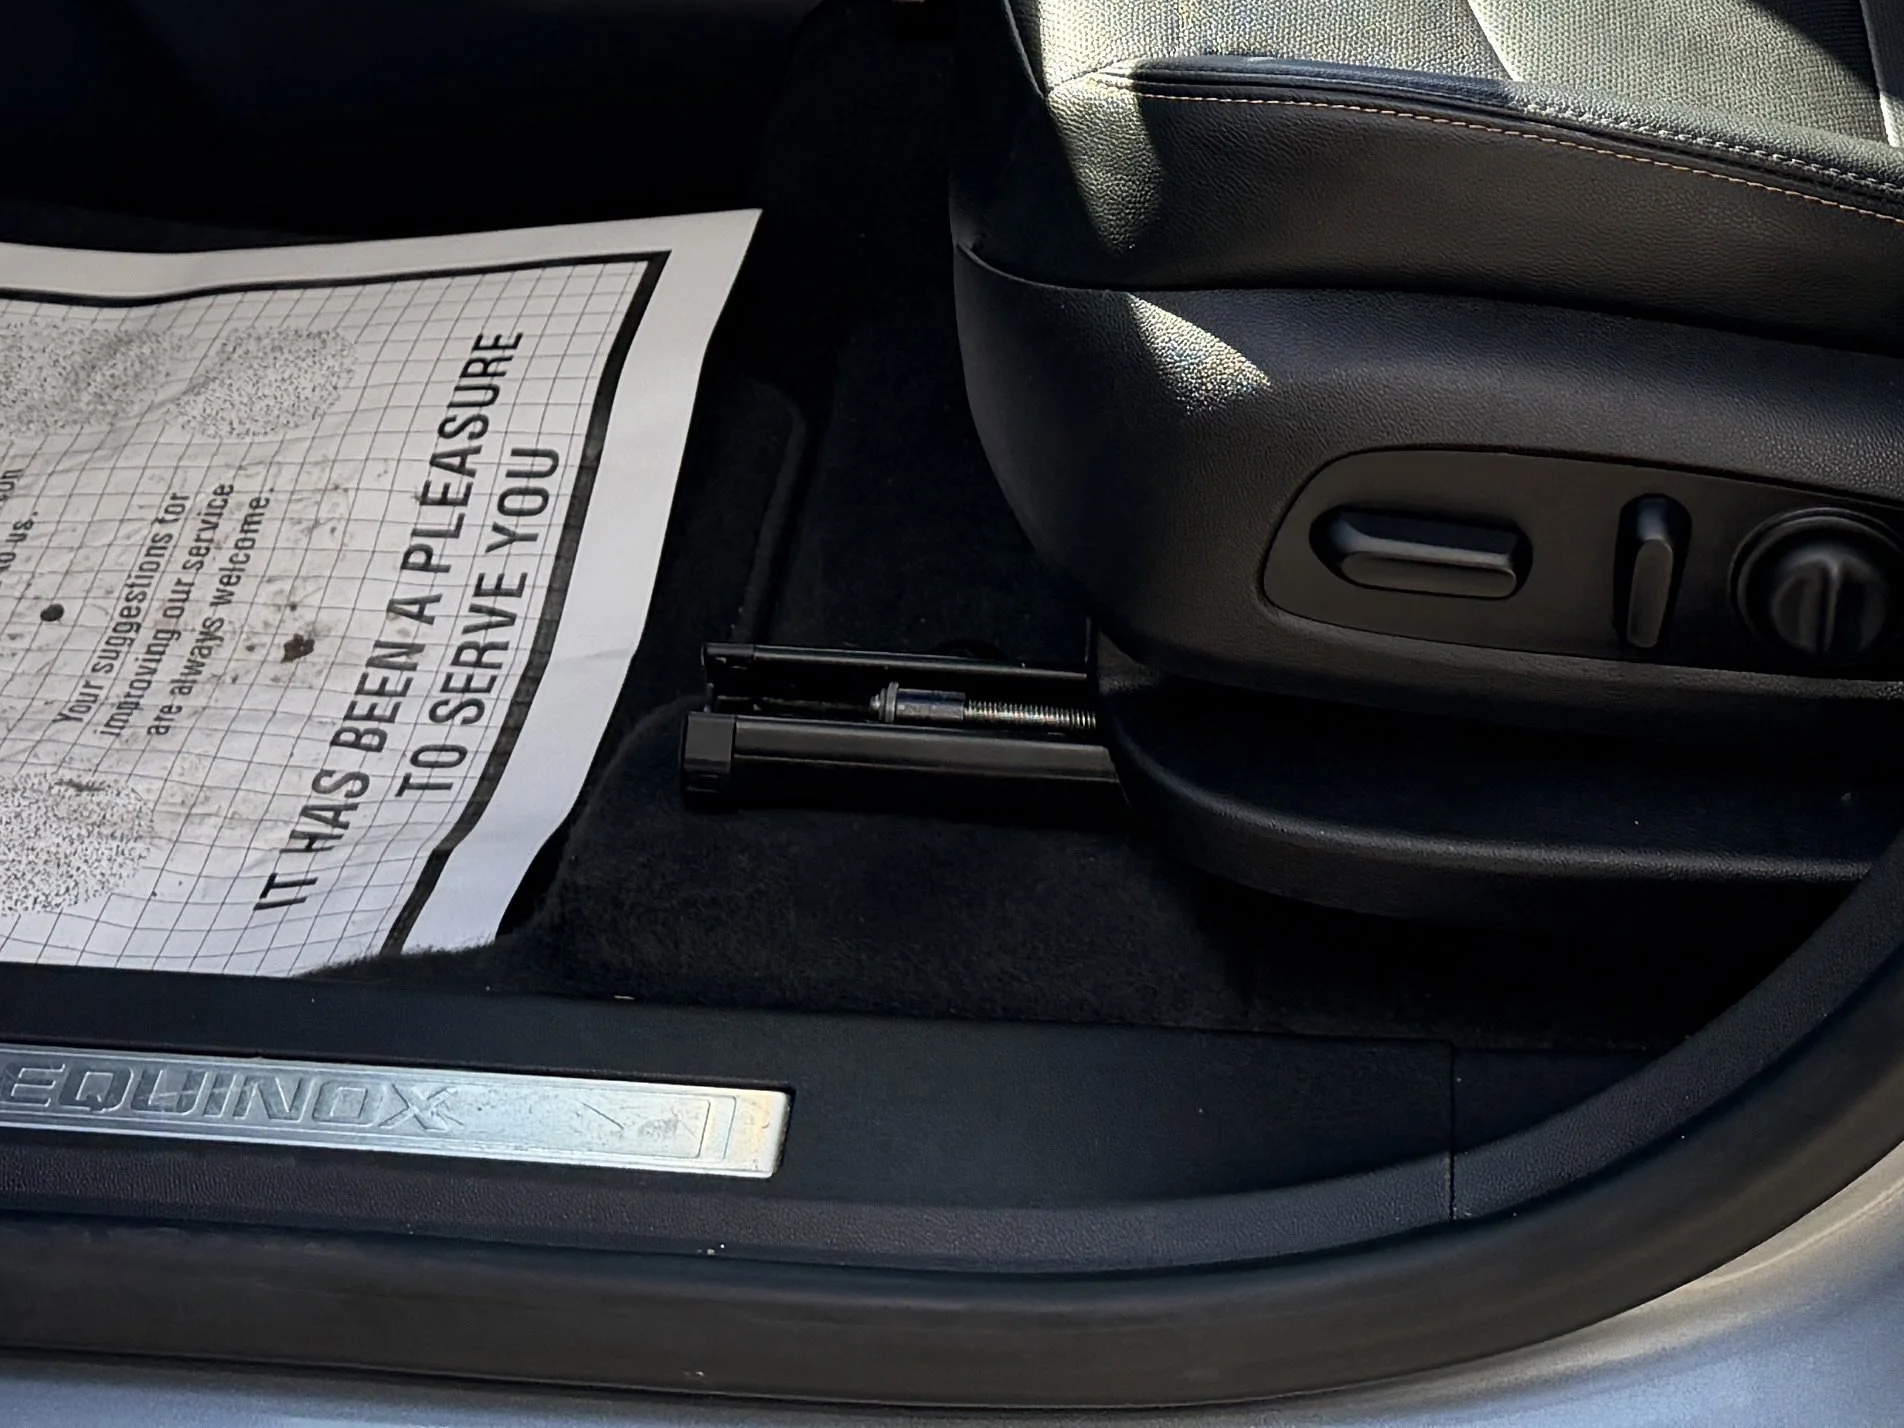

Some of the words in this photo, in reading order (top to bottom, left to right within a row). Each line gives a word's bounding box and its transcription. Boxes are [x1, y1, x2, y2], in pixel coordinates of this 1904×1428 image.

[400, 332, 523, 574] PLEASURE
[486, 447, 560, 555] YOU
[5, 511, 38, 546] us.
[51, 679, 104, 724] Your
[91, 532, 174, 674] suggestions
[93, 628, 181, 737] improving
[162, 578, 195, 619] our
[182, 483, 234, 571] service
[147, 704, 182, 736] are
[170, 616, 224, 696] always
[209, 487, 274, 607] welcome.
[386, 593, 443, 626] A
[428, 572, 528, 726] SERVE
[329, 639, 426, 753] BEEN
[278, 769, 370, 856] HAS
[395, 743, 467, 797] TO
[253, 873, 318, 911] IT
